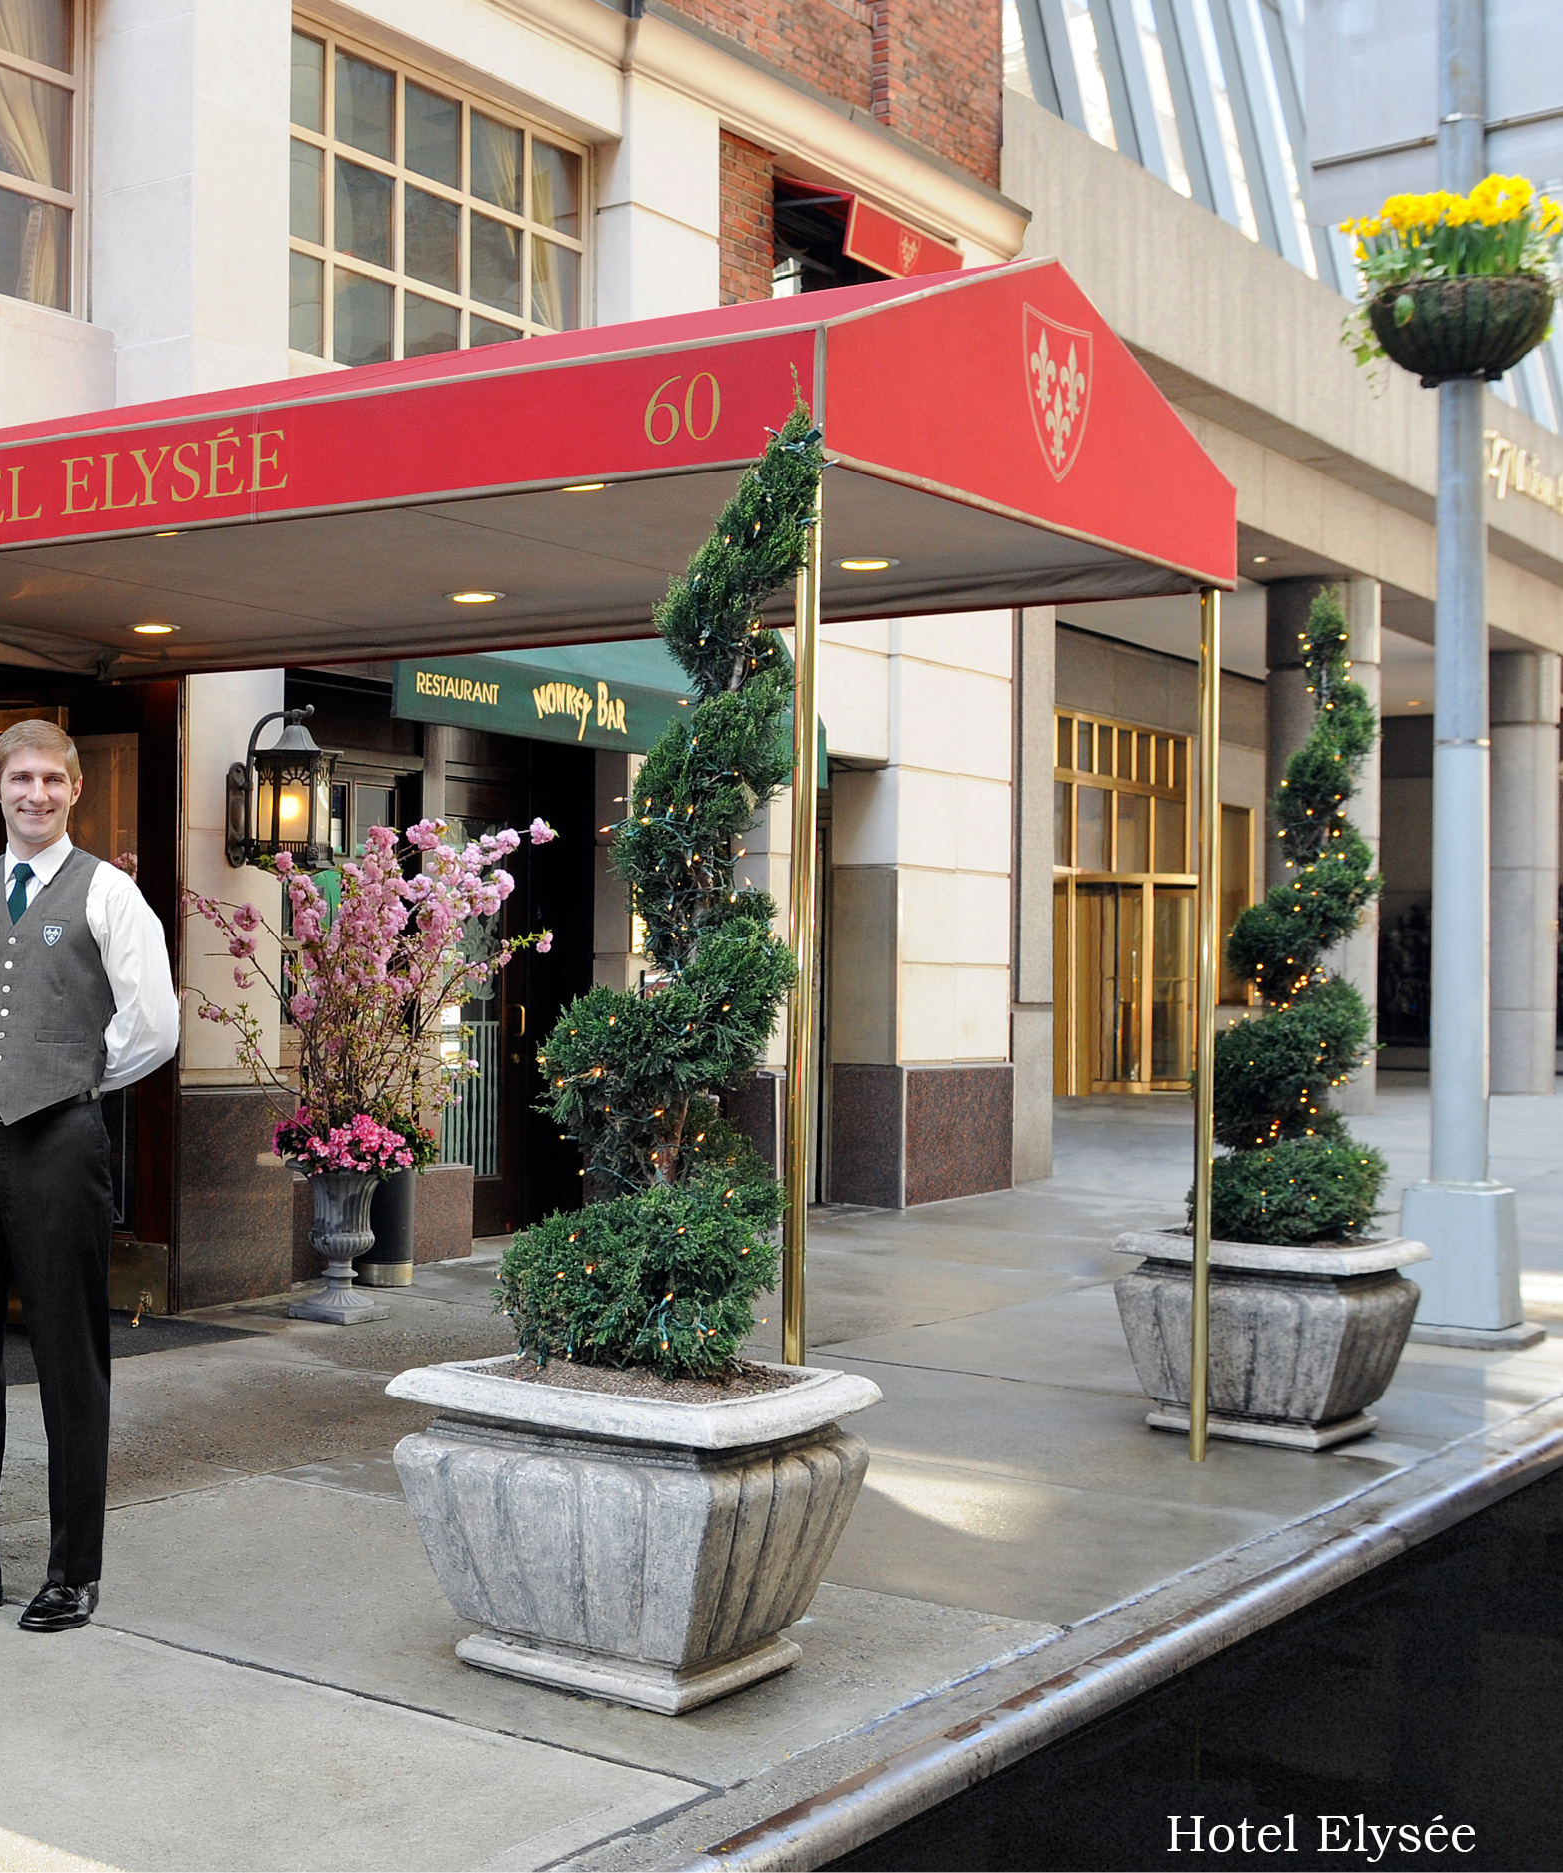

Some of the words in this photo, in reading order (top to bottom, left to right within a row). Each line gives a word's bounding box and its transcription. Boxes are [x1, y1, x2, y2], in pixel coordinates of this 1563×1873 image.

[643, 371, 721, 446] 60
[59, 426, 289, 516] ELYSÉE
[415, 670, 500, 706] RESTAURANT
[532, 681, 593, 742] MONKEY
